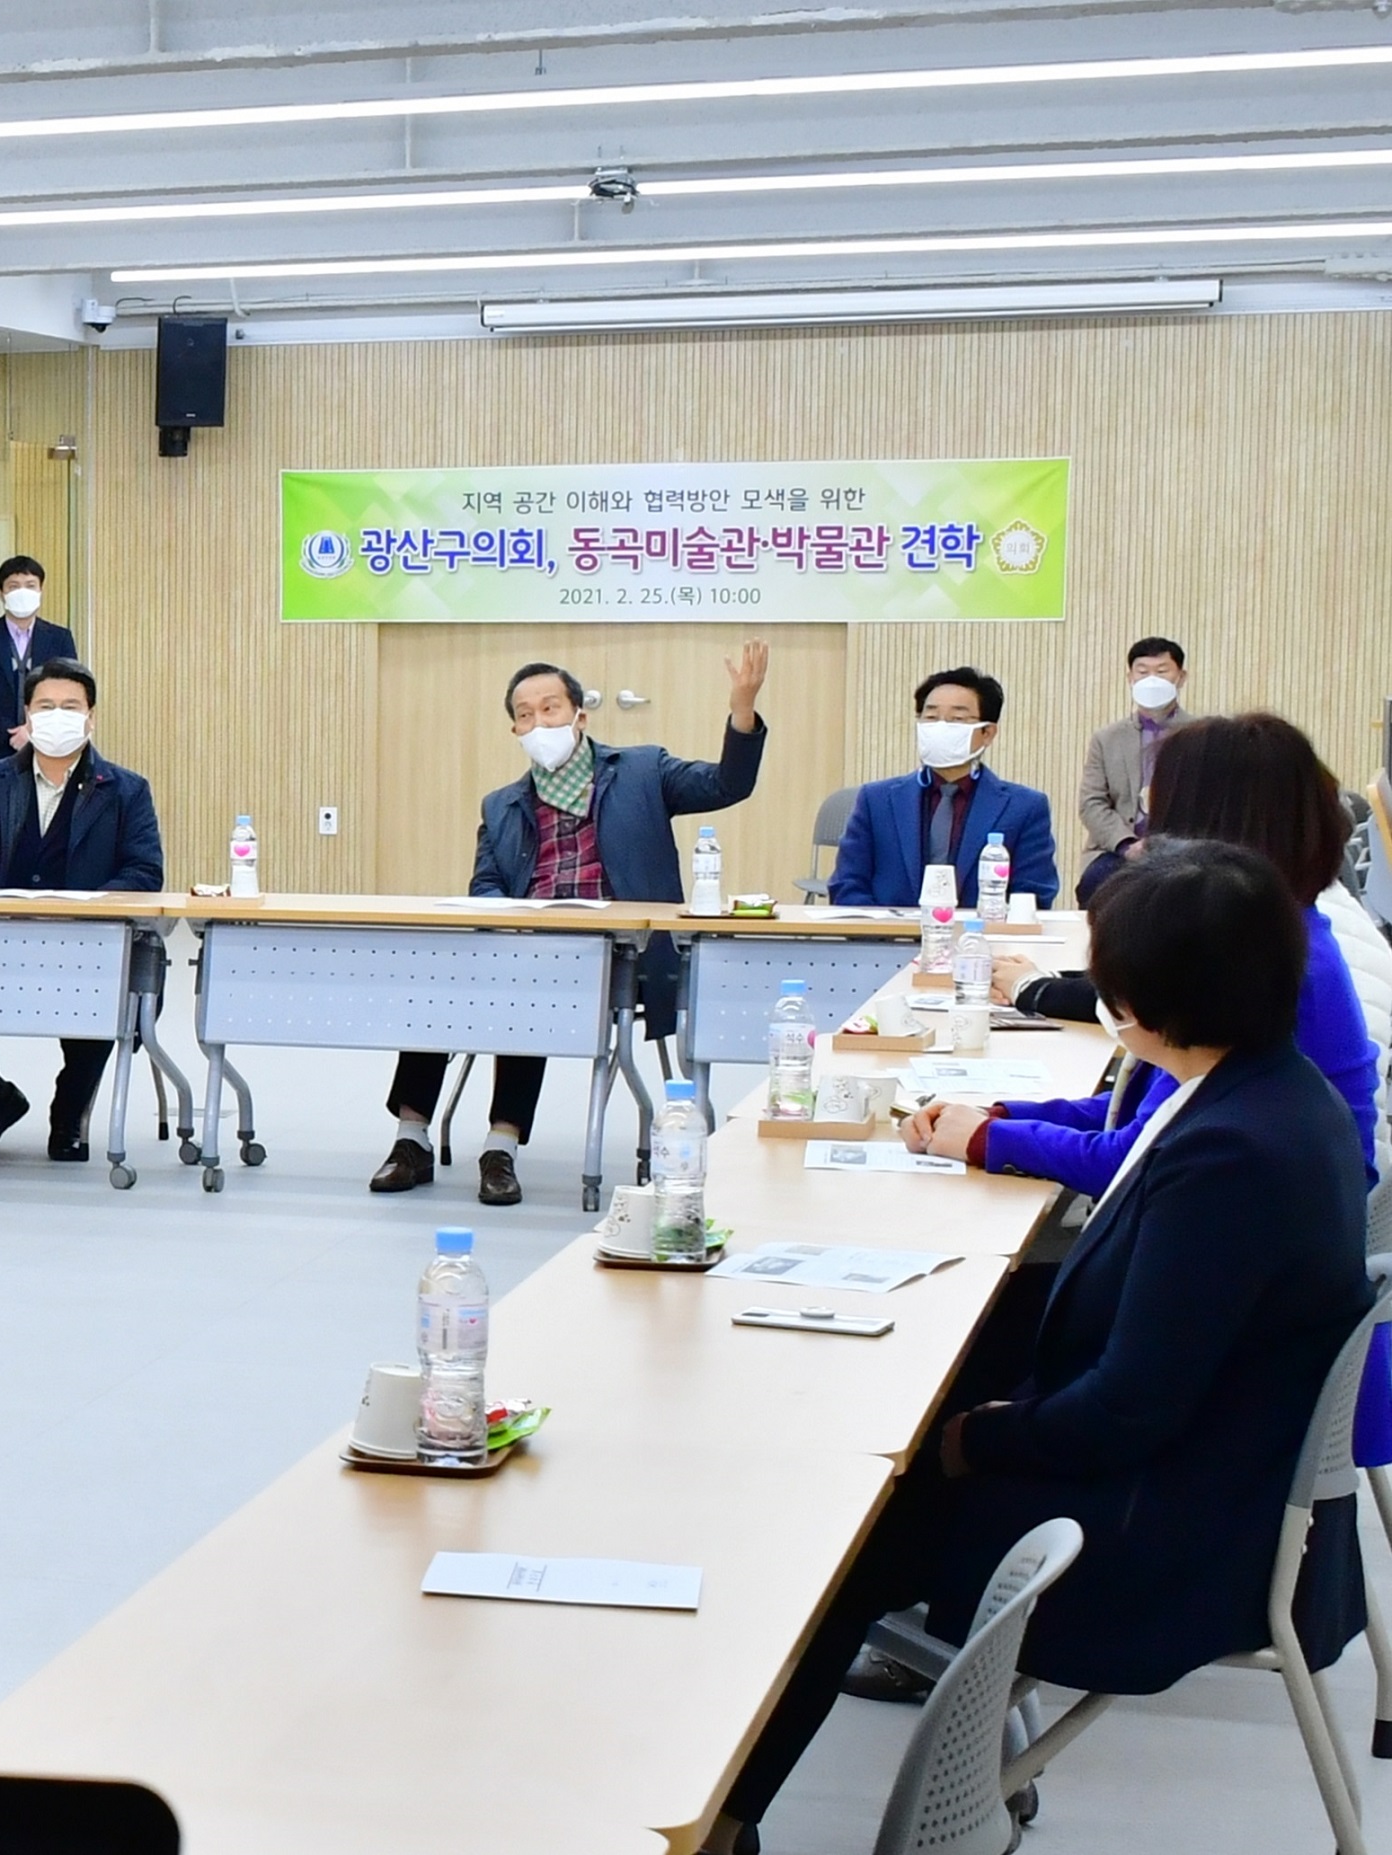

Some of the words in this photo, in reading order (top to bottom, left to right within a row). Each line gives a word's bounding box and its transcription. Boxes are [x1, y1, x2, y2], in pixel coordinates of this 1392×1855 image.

[462, 491, 502, 514] 지역
[513, 491, 556, 514] 공간
[566, 490, 633, 513] 이해와
[644, 489, 730, 513] 협력방안
[741, 488, 809, 512] 모색을
[820, 487, 866, 511] 위한
[360, 528, 555, 574] 광산구의회,
[568, 525, 890, 571] 동곡미술관·박물관
[901, 524, 980, 569] 견학
[559, 588, 608, 605] 2021.
[617, 588, 633, 605] 2.
[640, 586, 702, 606] 25.(목)
[710, 588, 761, 604] 10:00
